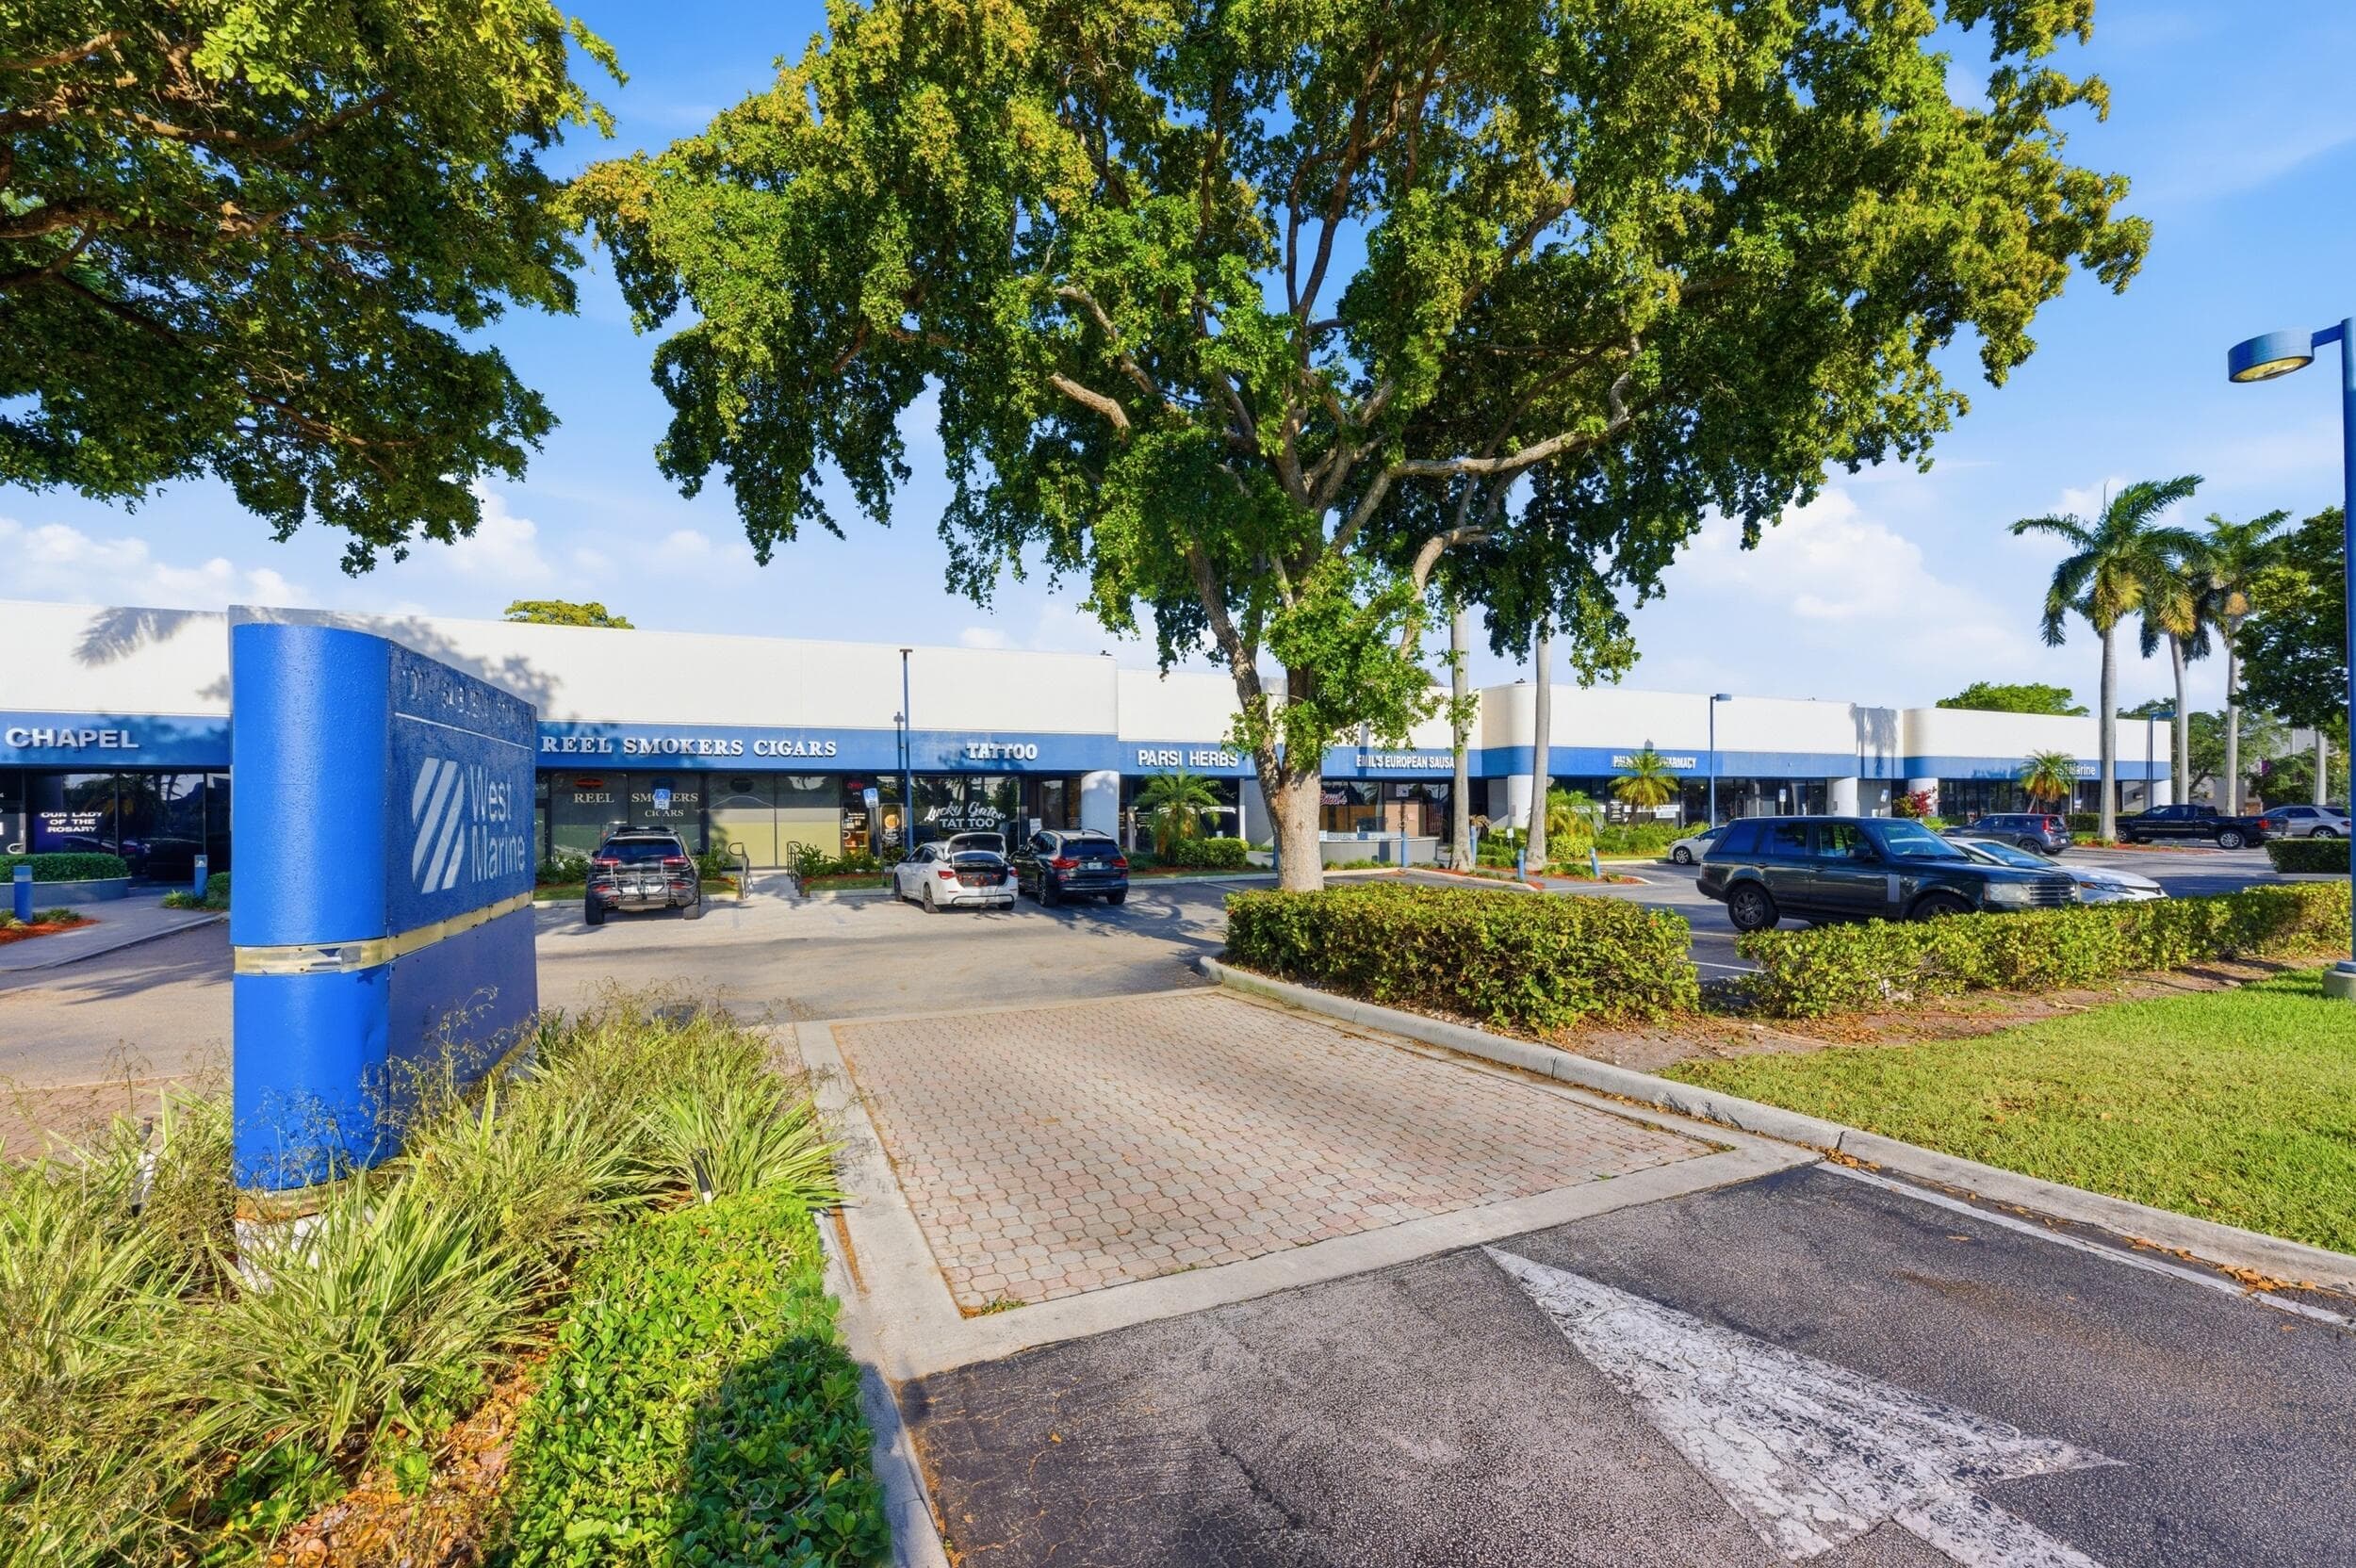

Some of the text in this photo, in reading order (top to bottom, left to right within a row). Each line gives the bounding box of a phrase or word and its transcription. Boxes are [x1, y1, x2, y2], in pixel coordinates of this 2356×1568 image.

[5, 727, 139, 748] CHAPEL
[541, 736, 837, 756] REEL SMOKERS CIGARS
[966, 742, 1038, 760] TATTOO
[1137, 749, 1238, 767] PARSI HERBS
[1357, 754, 1455, 769] EMIL'S EUROPEAN SAUSA
[470, 762, 511, 823] West
[574, 792, 698, 803] REEL SMERS
[924, 801, 1006, 822] Lucky Gator
[471, 822, 525, 883] Marine
